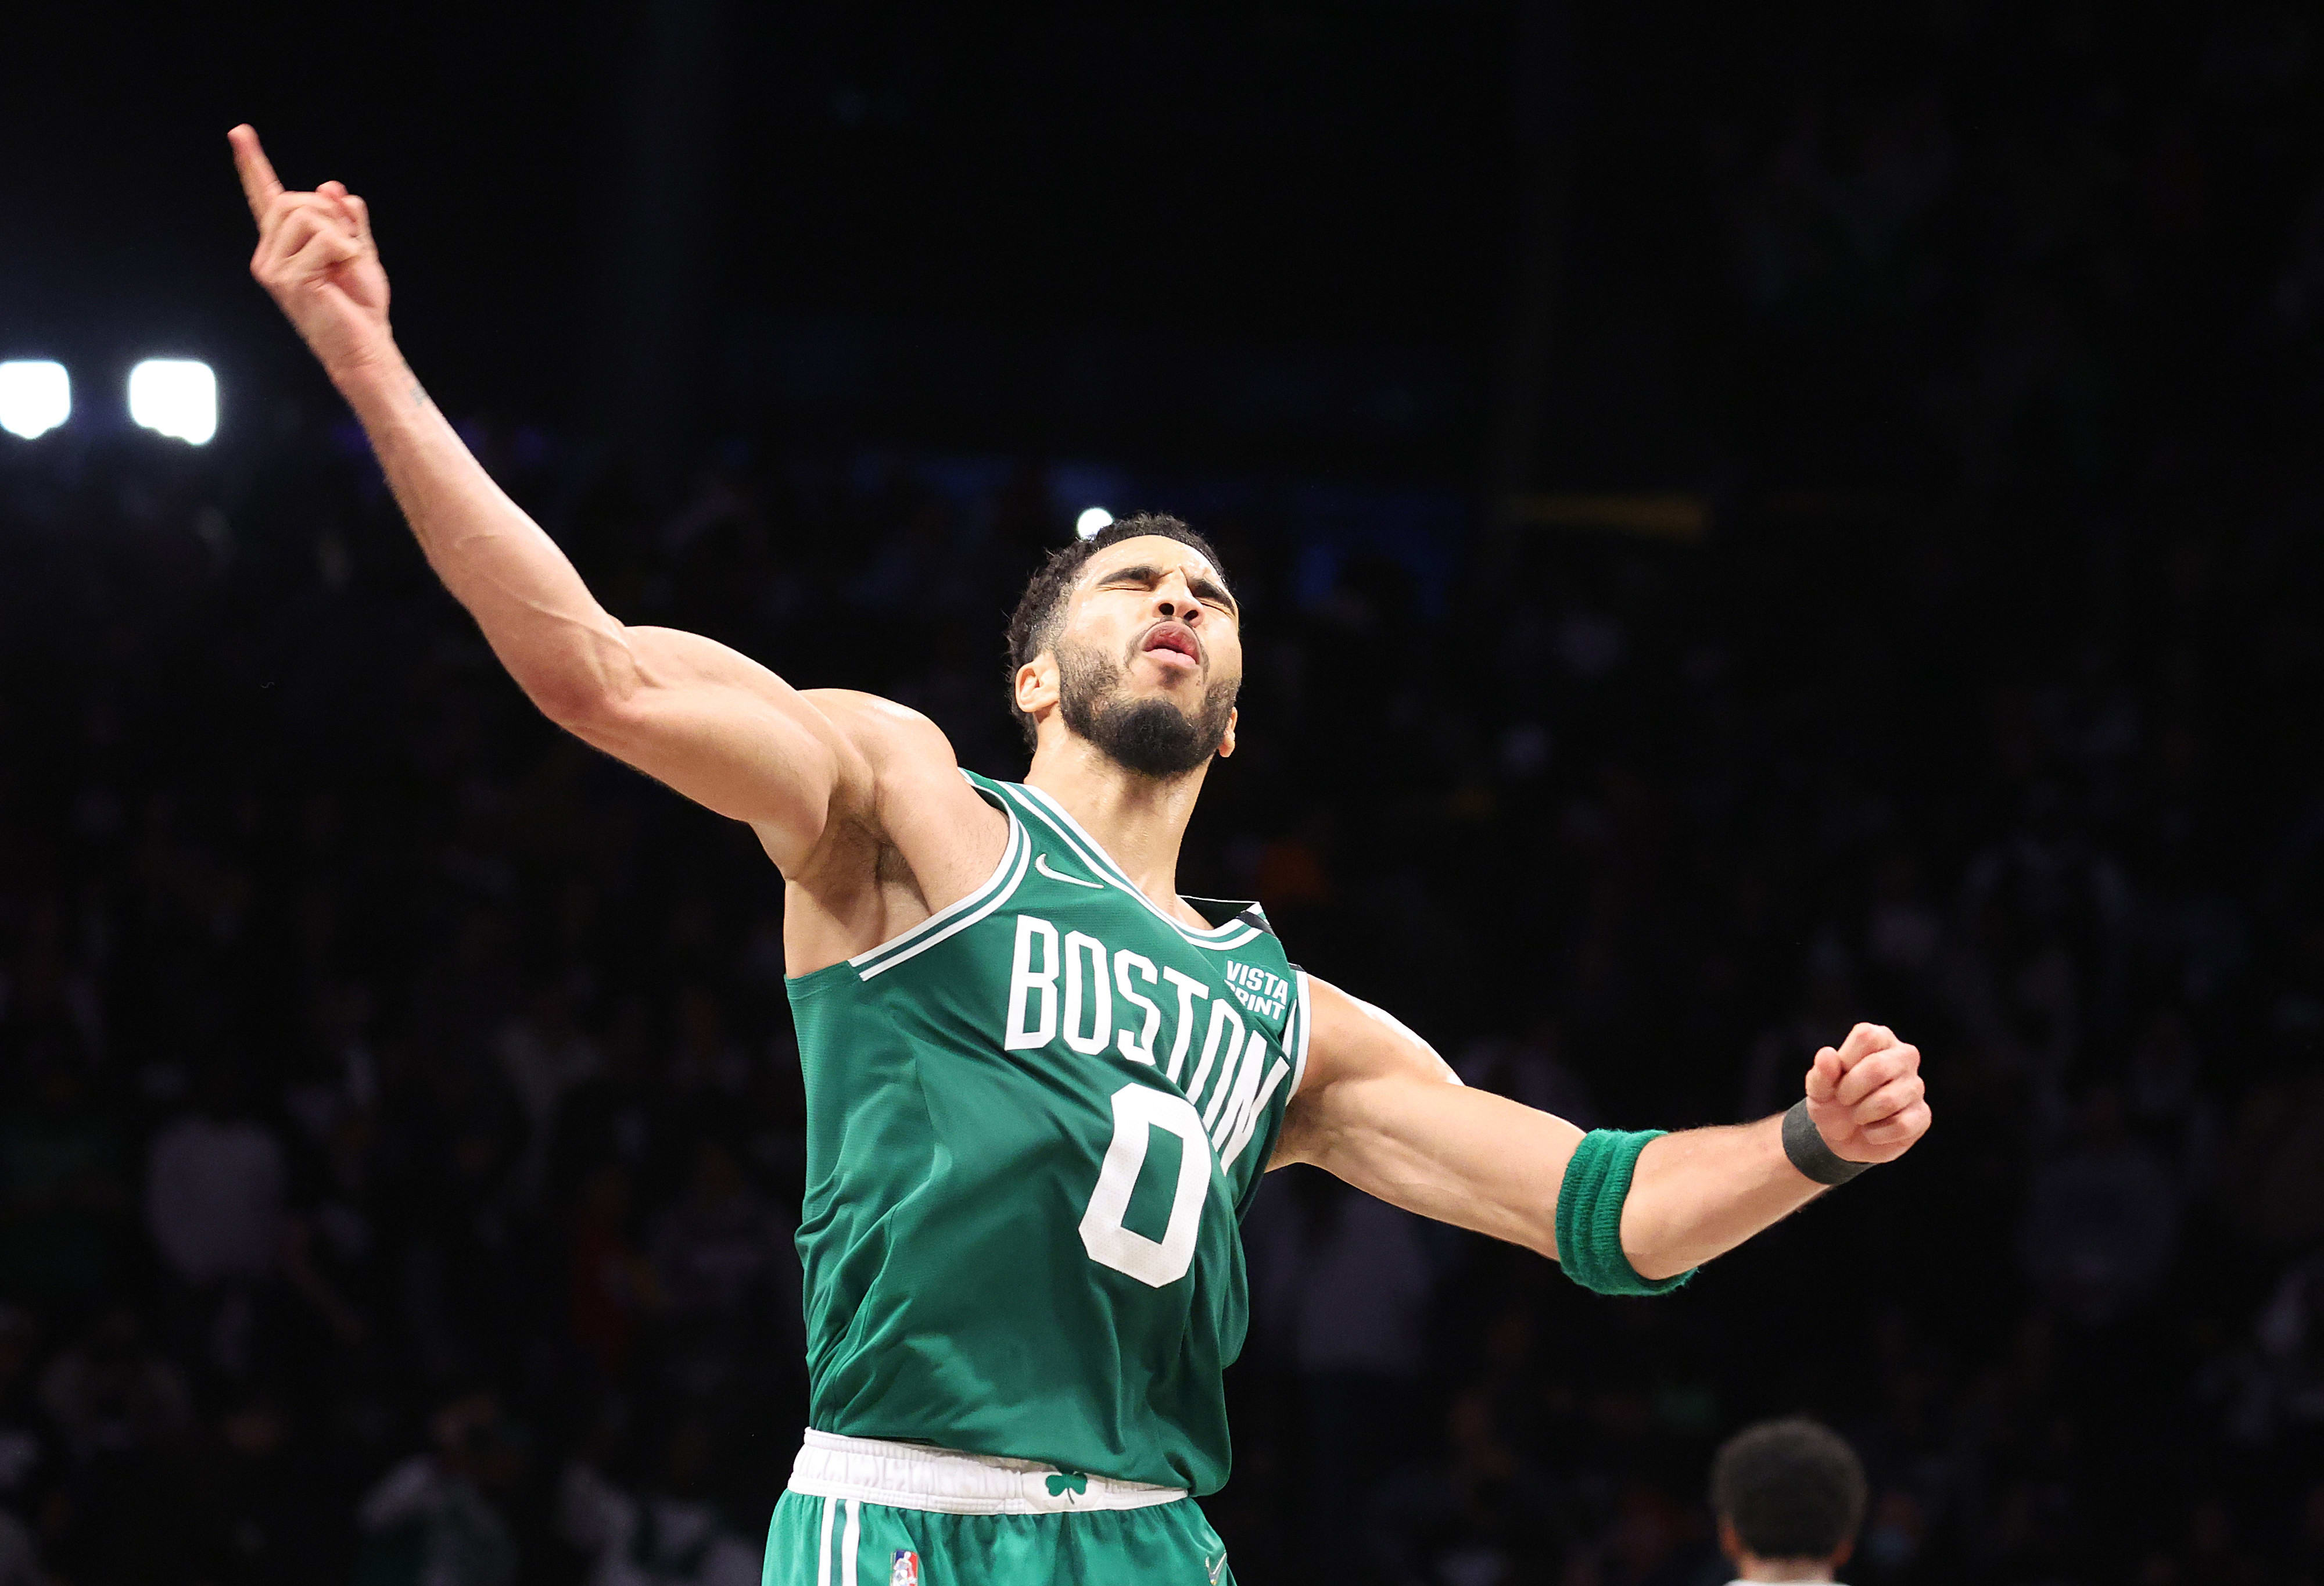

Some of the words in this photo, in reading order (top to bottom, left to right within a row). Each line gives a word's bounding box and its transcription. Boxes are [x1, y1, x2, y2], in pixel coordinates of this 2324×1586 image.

[1005, 914, 1290, 1177] BOSTON
[1226, 960, 1289, 1005] VISTA
[1078, 1082, 1212, 1288] 0
